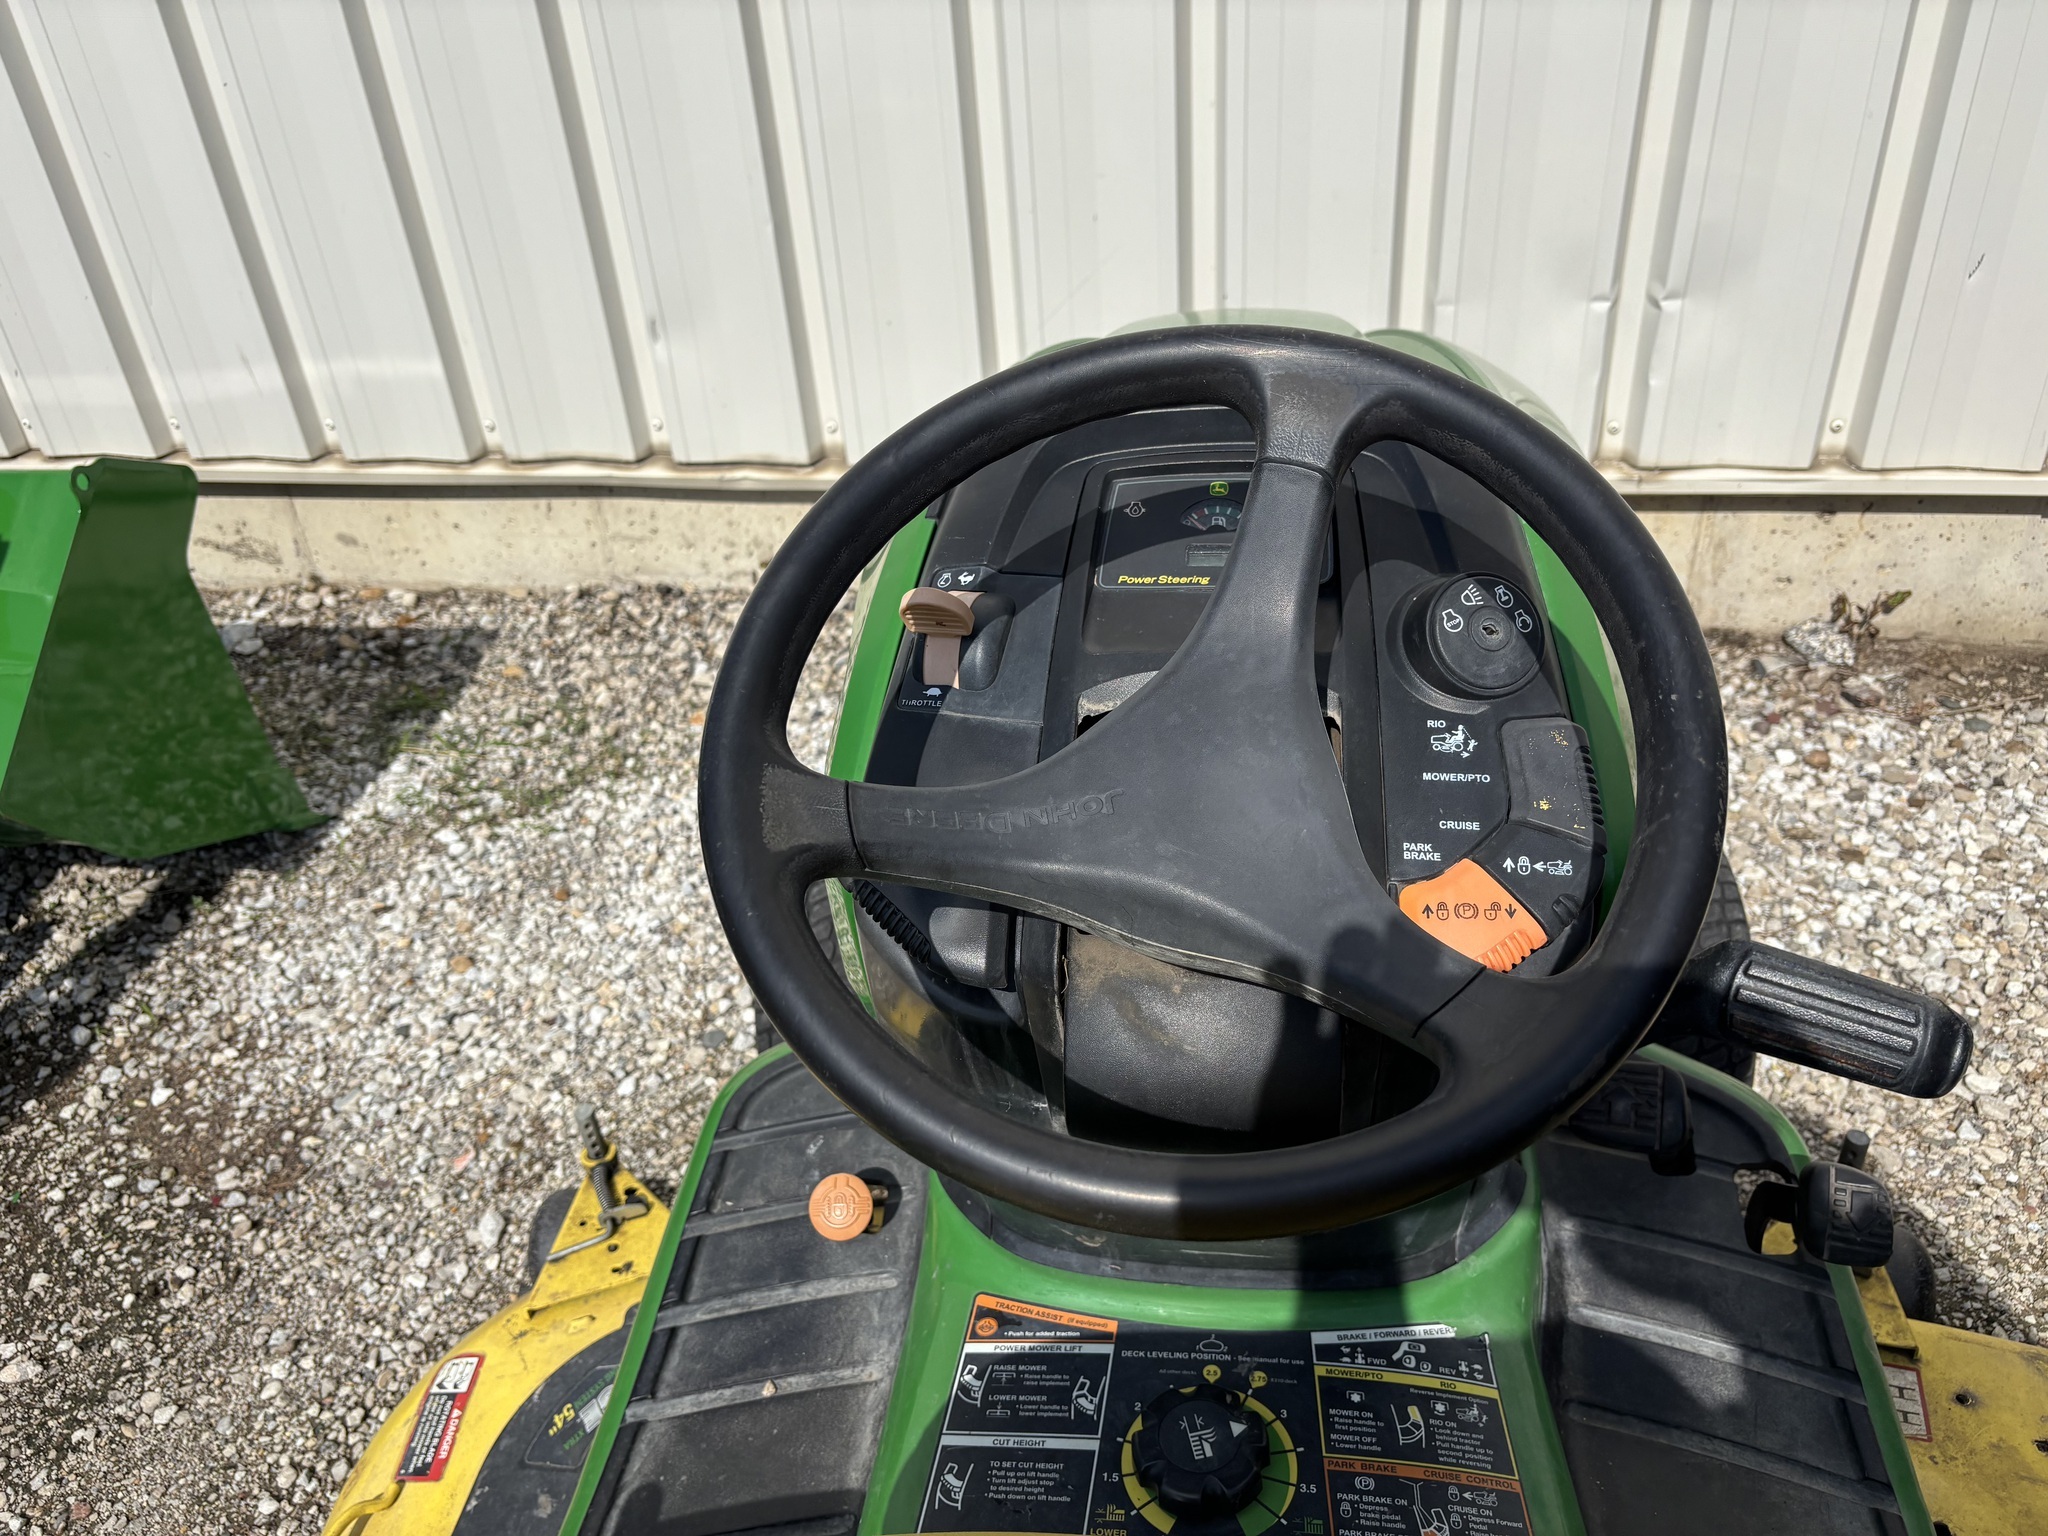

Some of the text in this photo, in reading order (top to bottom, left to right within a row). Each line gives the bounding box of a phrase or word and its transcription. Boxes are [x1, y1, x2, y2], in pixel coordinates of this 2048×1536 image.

[1118, 575, 1211, 585] Power Steering
[1446, 618, 1460, 628] STOP
[901, 699, 942, 707] THROTTLE
[1427, 720, 1446, 728] RIO
[1422, 772, 1491, 783] MOWER/PTO
[1022, 788, 1124, 828] JOHN
[1439, 820, 1481, 831] CRUISE
[1403, 842, 1433, 852] PARK
[1403, 852, 1442, 861] BRAKE
[995, 1301, 1034, 1315] TRACTION
[1034, 1310, 1063, 1321] ASSIST
[1337, 1332, 1367, 1341] BRAKE
[1373, 1329, 1416, 1339] FORWARD
[1121, 1350, 1145, 1358] DECK
[1147, 1351, 1189, 1359] LEVELING
[1190, 1353, 1231, 1361] POSITION
[1367, 1357, 1387, 1365] FWD
[1325, 1368, 1383, 1380] MOWER/PTO
[1439, 1367, 1456, 1376] REV
[1440, 1381, 1457, 1390] RIO
[1410, 1388, 1489, 1405] Reverse Implement Option
[1134, 1402, 1142, 1411] 2
[1280, 1409, 1287, 1418] 3
[1329, 1408, 1360, 1417] MOWER
[1334, 1417, 1352, 1425] Raise
[1353, 1418, 1376, 1426] handle
[1429, 1418, 1457, 1428] RIO ON
[1435, 1427, 1451, 1435] Look
[438, 1419, 459, 1459] DANGER
[1330, 1433, 1361, 1442] MOWER
[1435, 1434, 1458, 1442] behind
[1012, 1439, 1046, 1447] HEIGHT
[1358, 1443, 1382, 1451] handle
[1451, 1442, 1474, 1451] handle
[1437, 1449, 1493, 1461] second position
[1328, 1460, 1397, 1473] PARK BRAKE
[1458, 1458, 1492, 1469] reversing
[1102, 1472, 1119, 1482] 1.5
[1423, 1470, 1517, 1490] CRUISE CONTROL
[1300, 1483, 1317, 1493] 3.5
[1337, 1493, 1408, 1506] PARK BRAKE ON
[1359, 1503, 1389, 1512] Depress
[1448, 1504, 1493, 1516] CRUISE ON
[1359, 1511, 1401, 1521] brake pedal
[1360, 1519, 1406, 1529] Raise handle
[1468, 1515, 1523, 1528] Depress Forward
[1090, 1528, 1127, 1536] LOWER
[1469, 1523, 1488, 1531] Pedal
